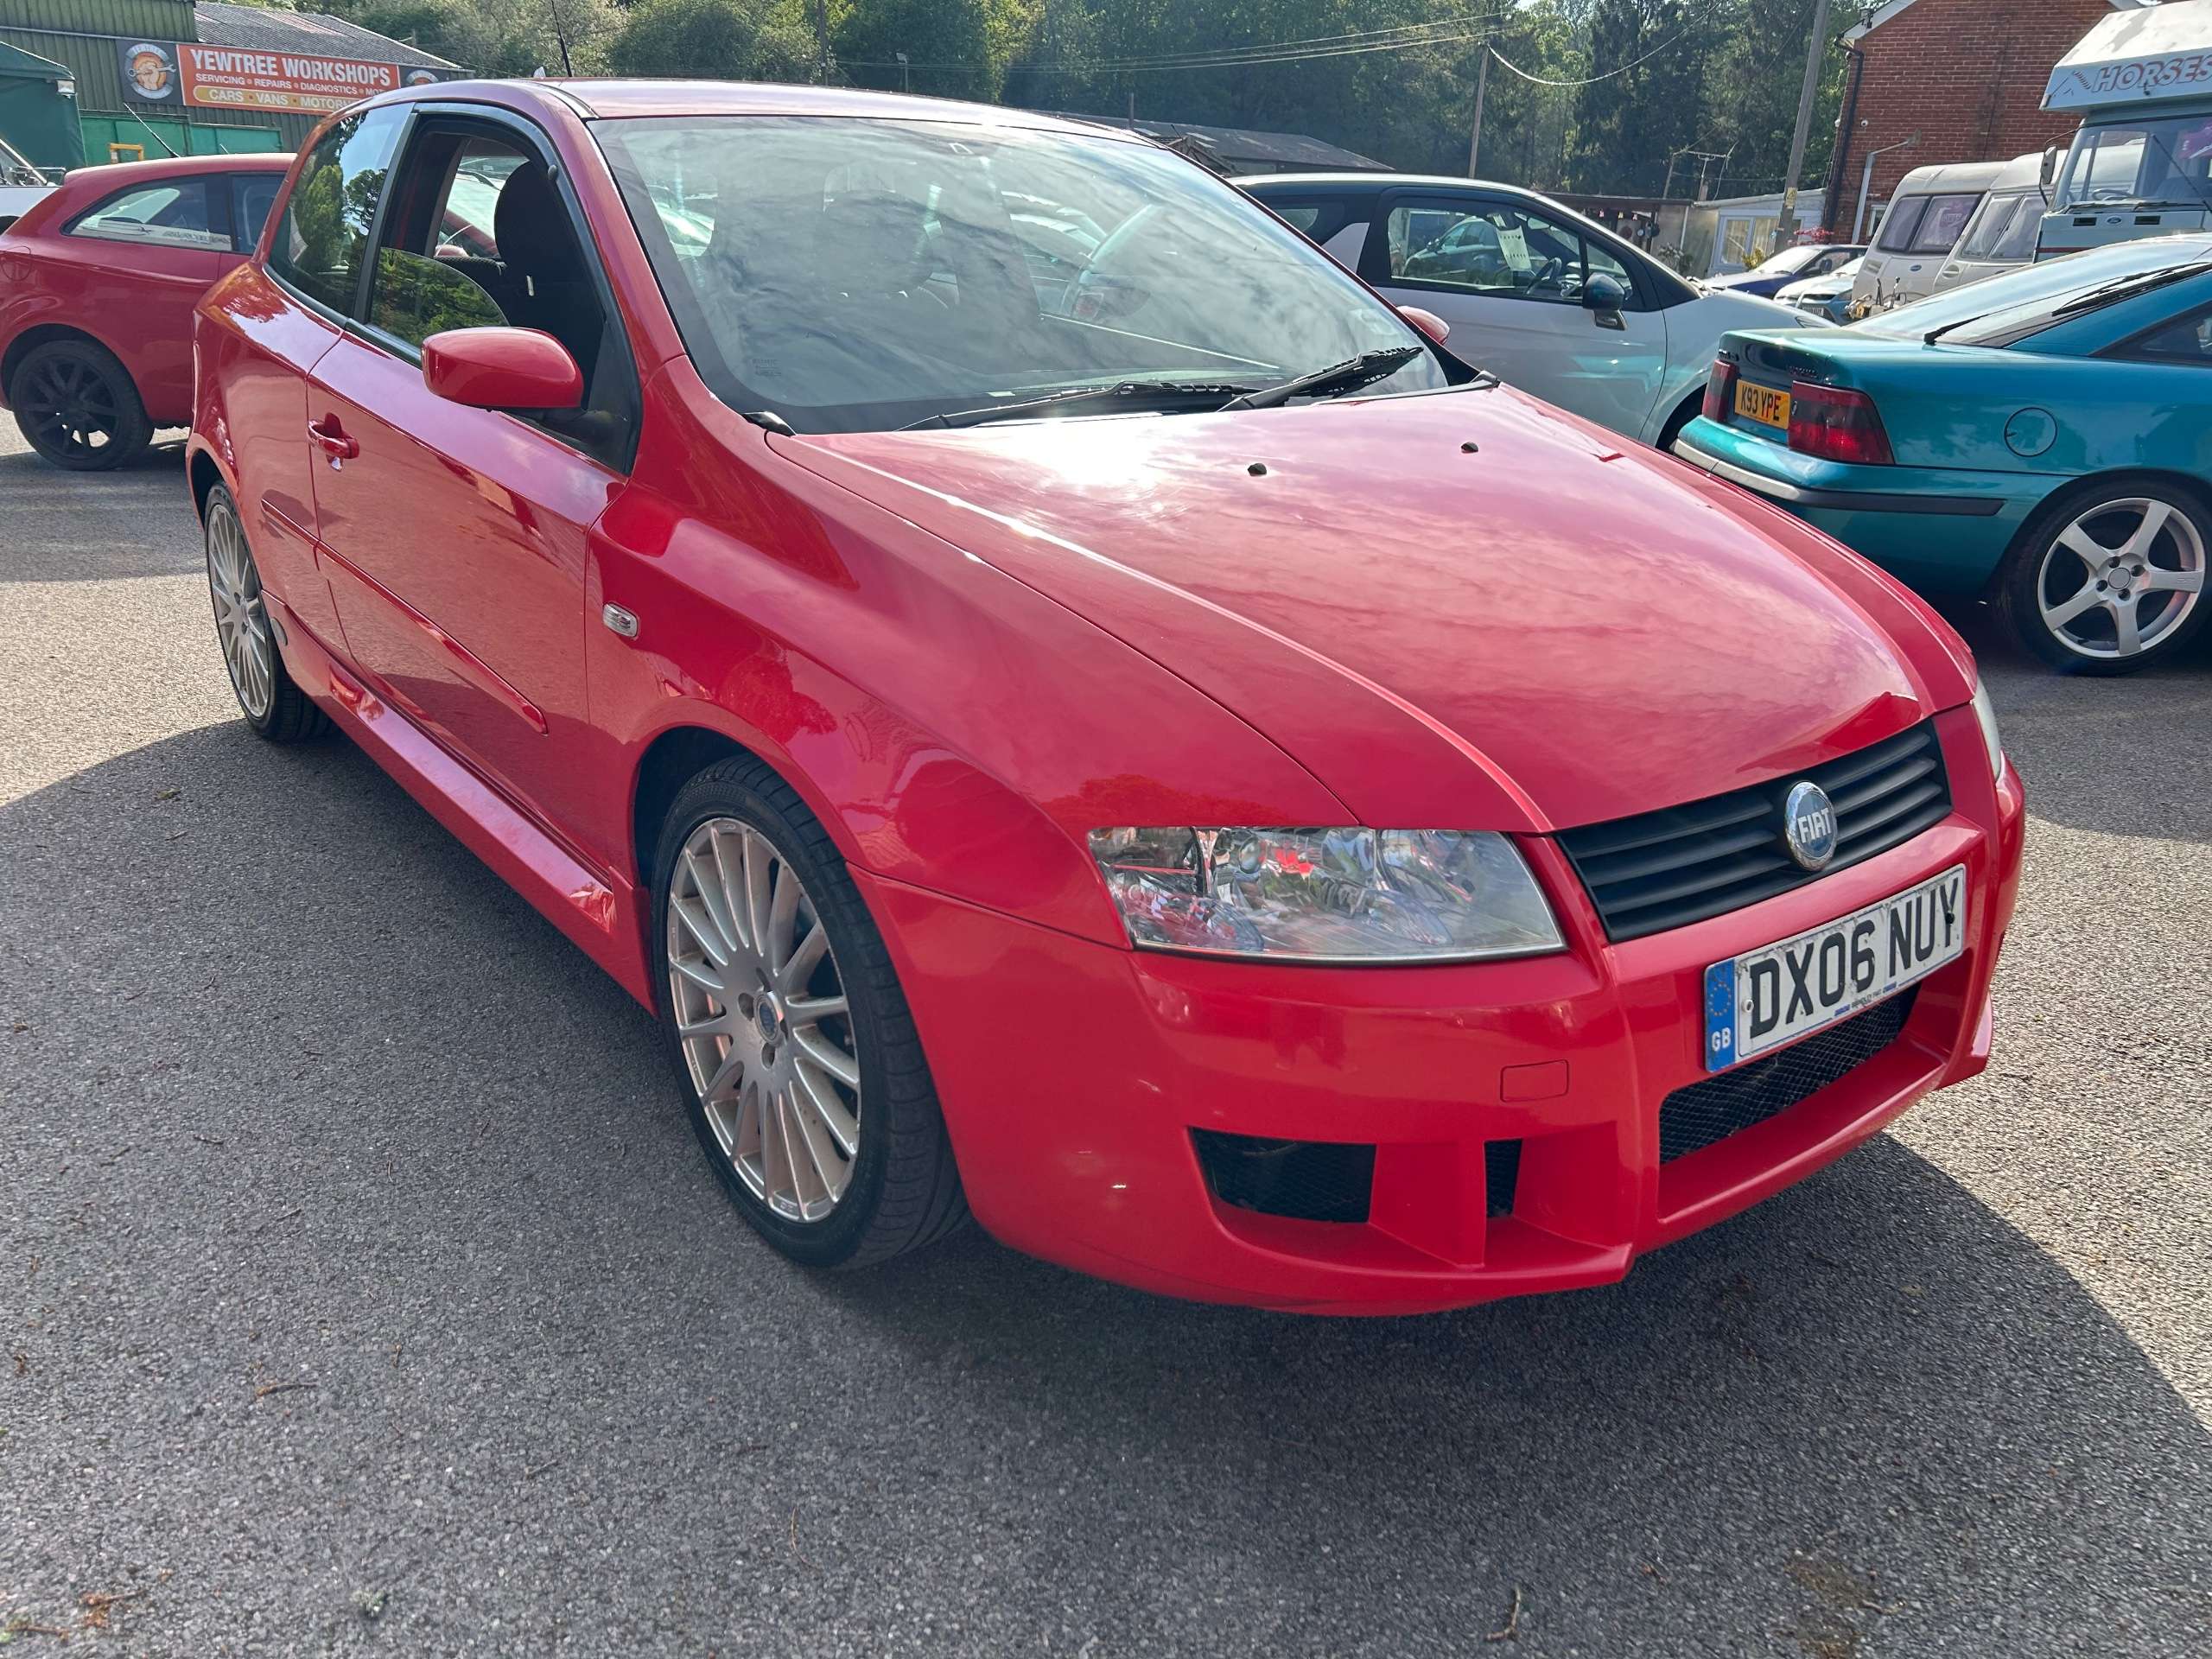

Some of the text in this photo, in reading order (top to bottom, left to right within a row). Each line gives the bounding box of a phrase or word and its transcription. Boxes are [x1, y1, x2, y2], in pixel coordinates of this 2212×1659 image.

[190, 48, 278, 76] YEWTREE
[282, 57, 391, 86] WORKSHOPS
[195, 73, 245, 85] SERVICING
[254, 78, 291, 89] REPAIRS
[300, 82, 358, 95] DIAGNOSTICS
[2091, 54, 2212, 93] HORSES
[208, 89, 245, 102] CARS
[256, 92, 289, 105] VANS
[1740, 385, 1782, 422] K93 YPE
[1797, 807, 1833, 845] FIAT
[1750, 876, 1959, 1039] DX06 NUY
[1711, 1027, 1732, 1052] GB
